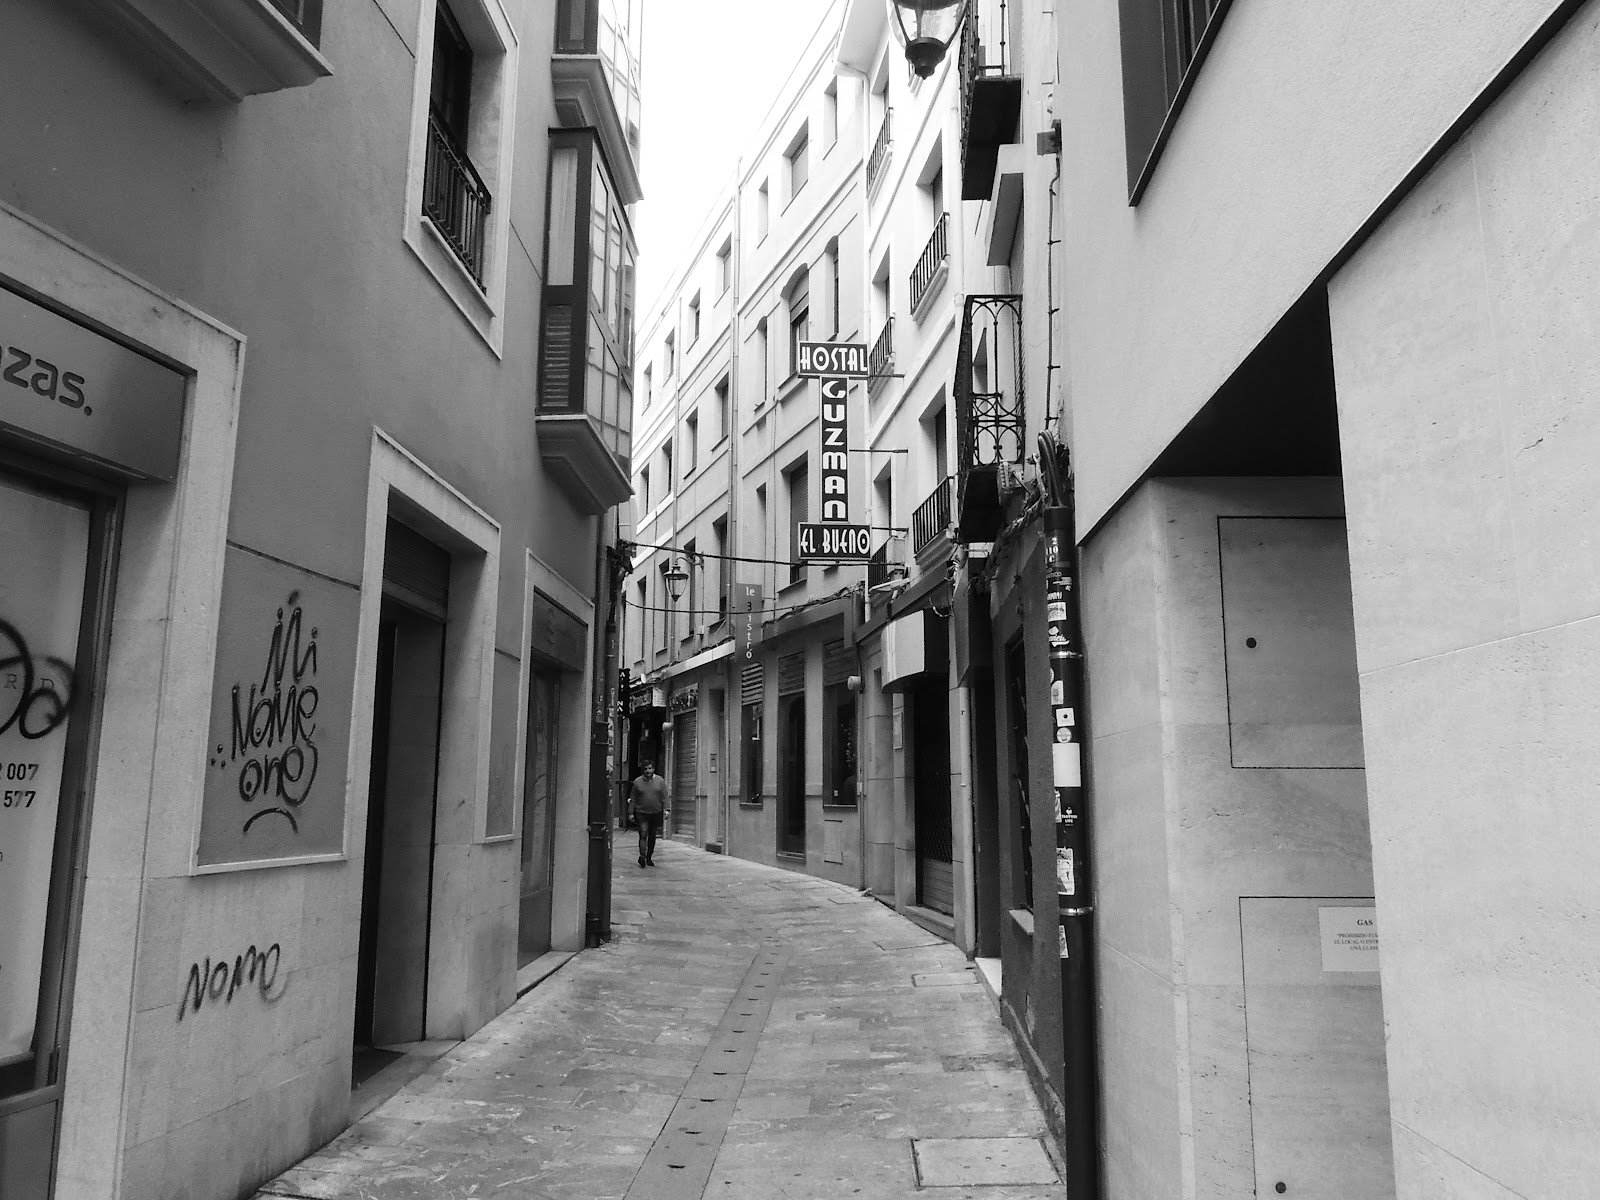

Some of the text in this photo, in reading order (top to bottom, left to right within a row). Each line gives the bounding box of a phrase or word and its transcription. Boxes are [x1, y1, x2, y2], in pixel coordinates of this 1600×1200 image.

[800, 346, 868, 372] HOSTAL
[0, 345, 93, 416] zas.
[822, 380, 847, 519] GUZMAN
[800, 528, 870, 554] EL BUENO
[745, 586, 756, 597] le
[7, 763, 39, 780] 007
[3, 790, 36, 808] 577
